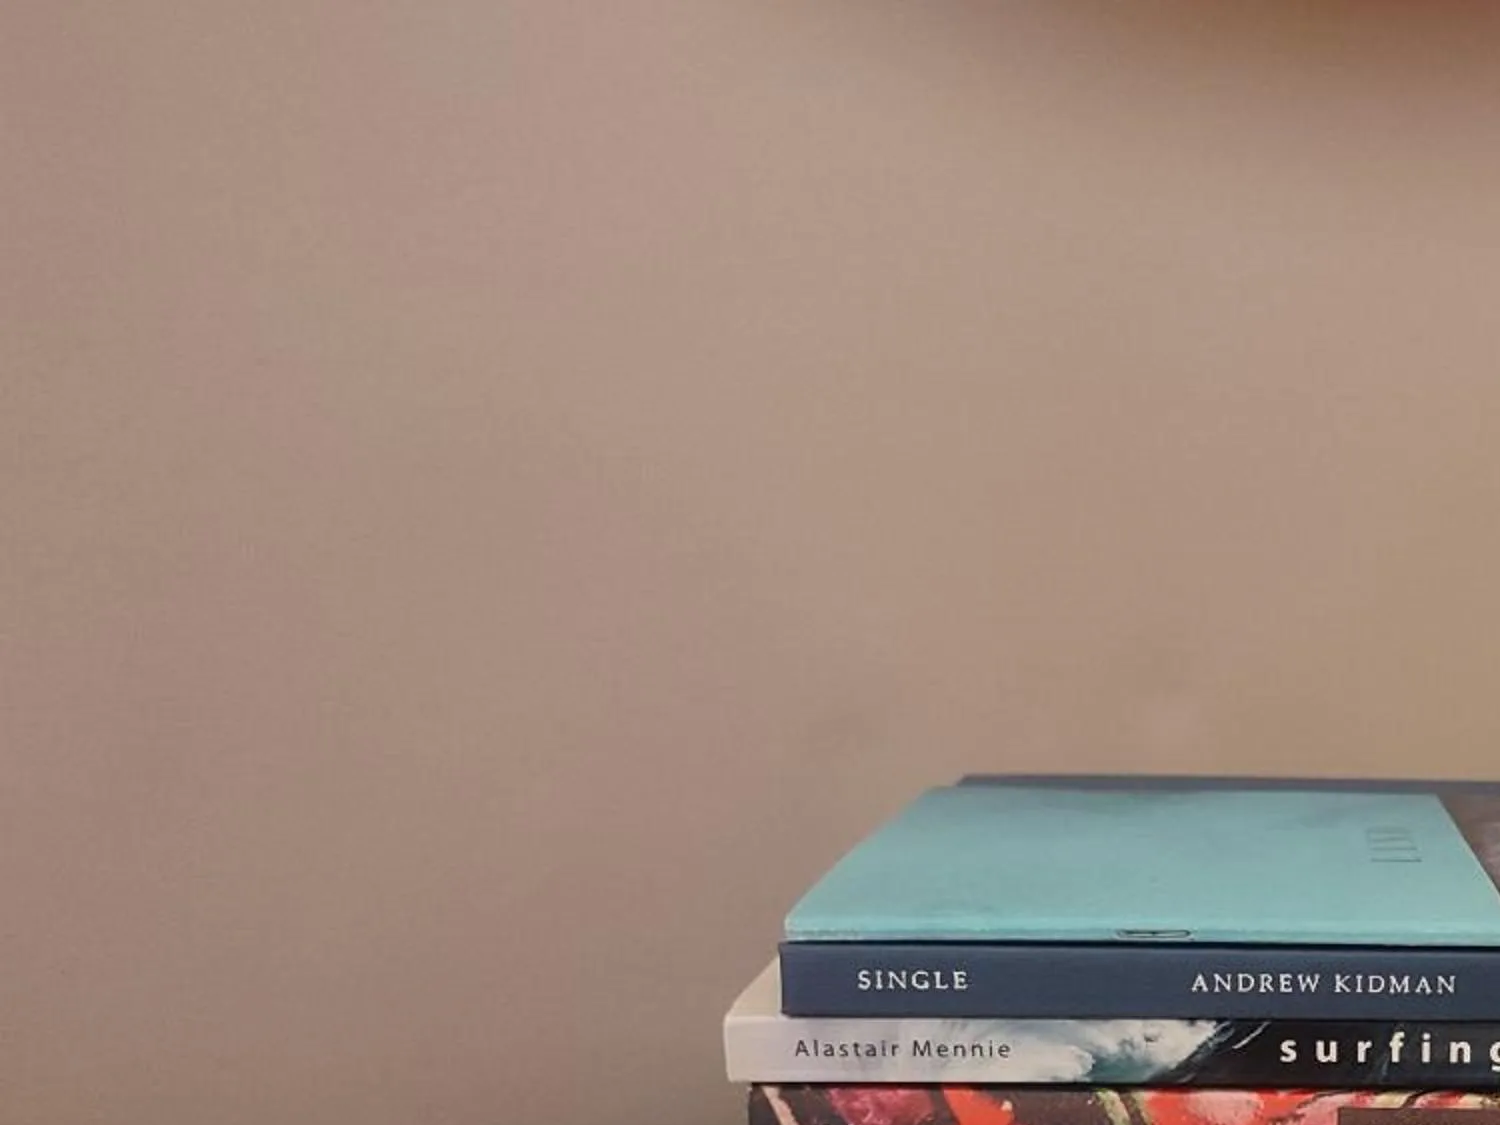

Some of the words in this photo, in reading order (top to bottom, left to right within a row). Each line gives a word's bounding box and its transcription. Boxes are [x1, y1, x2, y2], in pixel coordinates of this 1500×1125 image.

[857, 969, 969, 993] SINGLE
[1191, 972, 1321, 996] ANDREW
[1334, 973, 1458, 996] KIDMAN
[795, 1039, 901, 1059] Alastair
[913, 1040, 1011, 1060] Mennie
